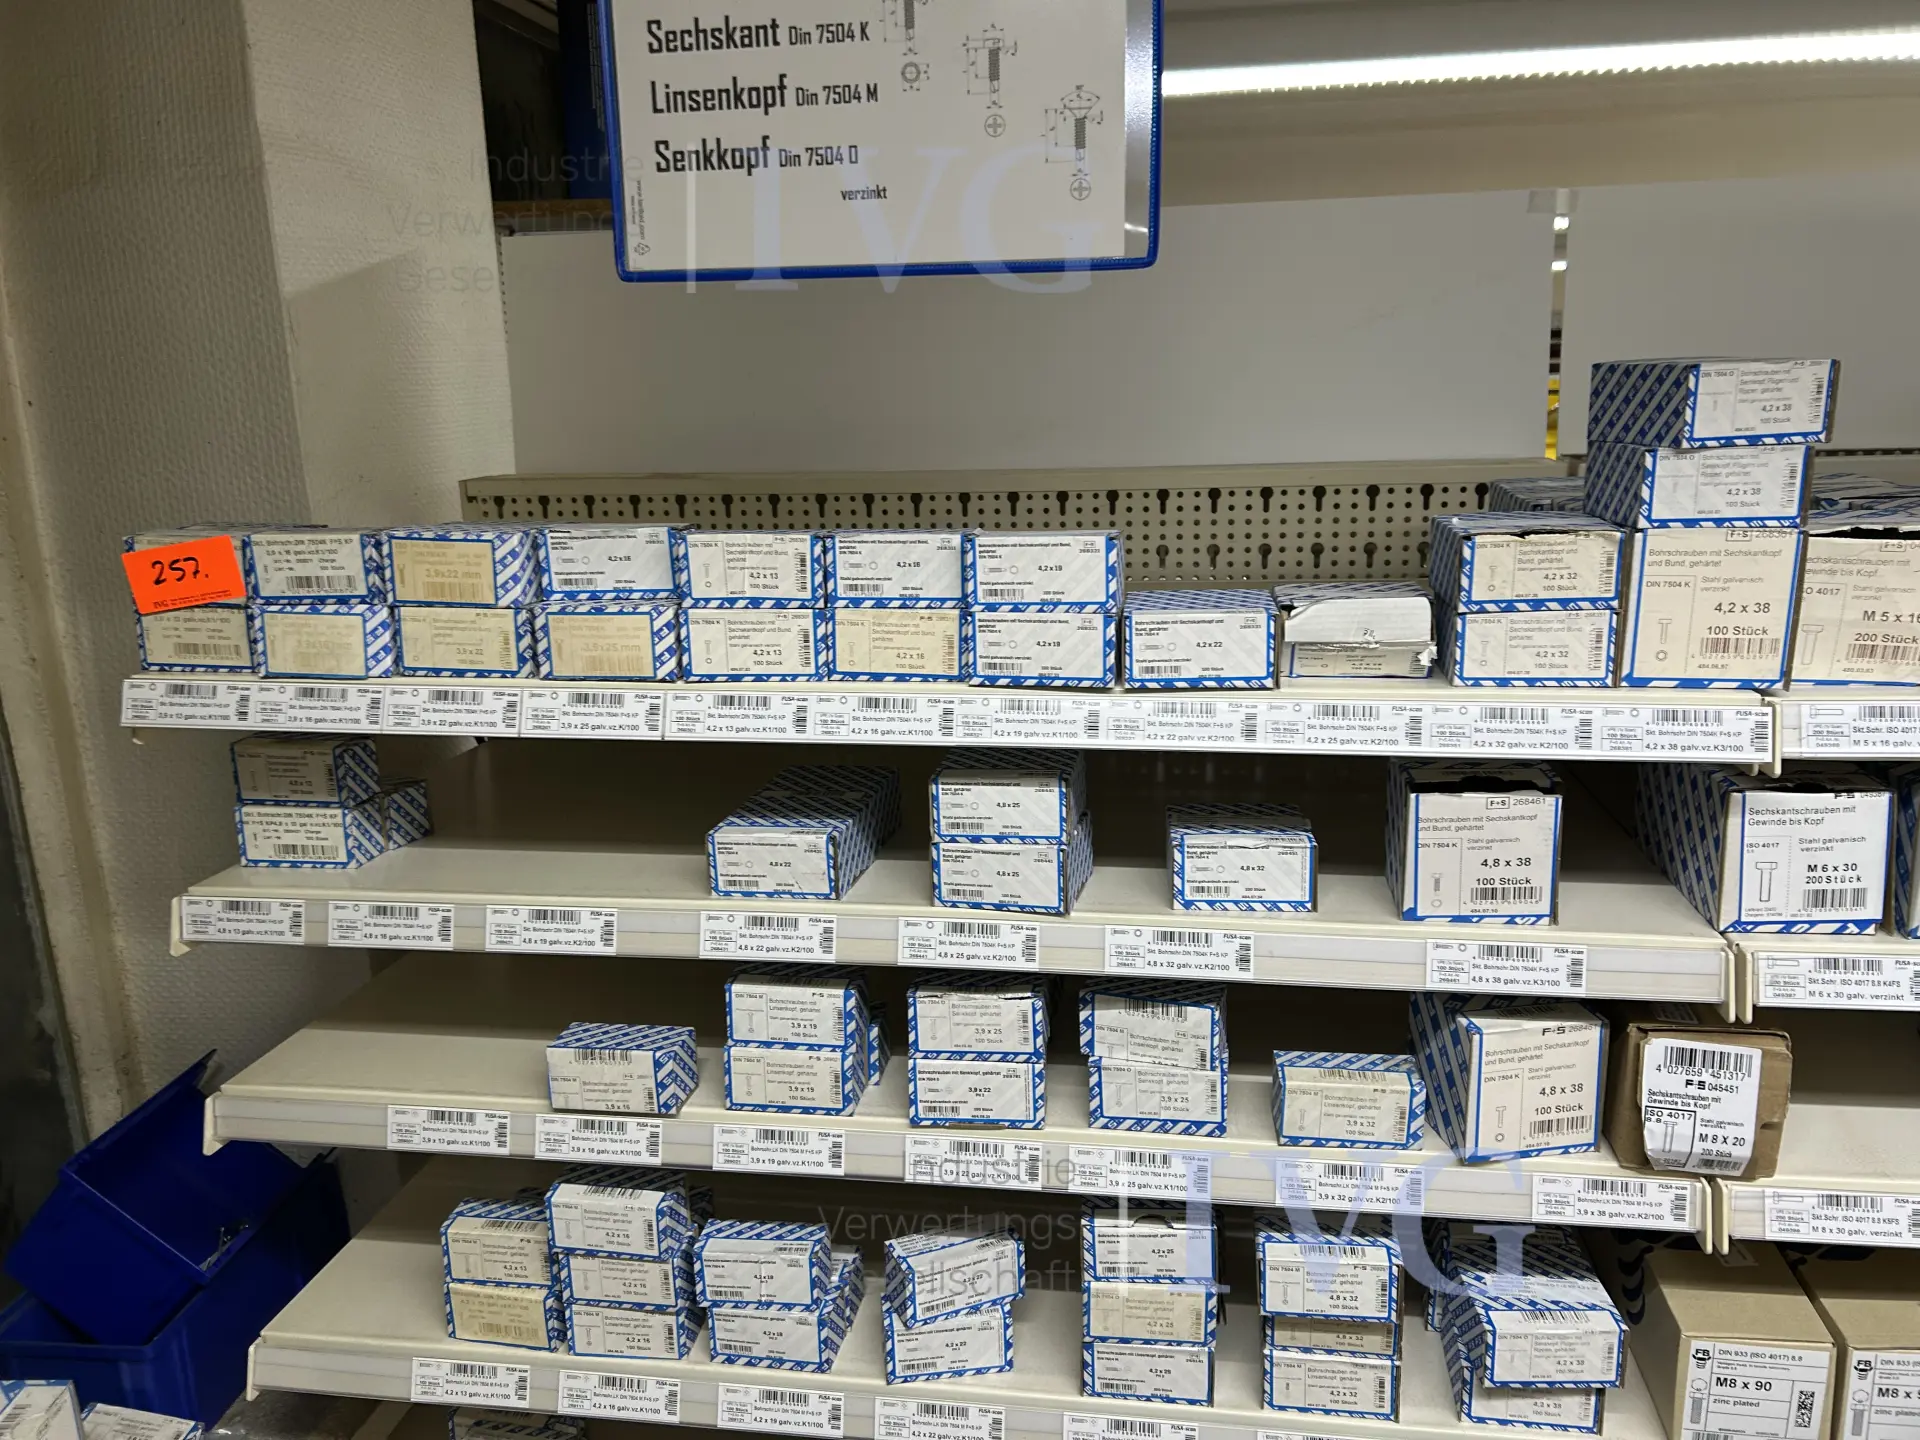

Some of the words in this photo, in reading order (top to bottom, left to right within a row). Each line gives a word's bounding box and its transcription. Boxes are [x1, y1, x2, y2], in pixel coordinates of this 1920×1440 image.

[647, 15, 780, 53] Sechskant
[789, 26, 811, 46] Din
[816, 23, 855, 44] 7504
[860, 21, 870, 41] K
[650, 74, 787, 115] Linsenkopf
[795, 87, 818, 107] Din
[823, 84, 861, 105] 7504
[867, 83, 878, 102] M
[655, 135, 770, 176] Senkkopf
[779, 149, 801, 168] Din
[806, 147, 843, 166] 7504
[840, 185, 887, 200] verzinkt
[1649, 549, 1708, 557] Bohrschrauben
[1724, 550, 1782, 558] Sechskantkopf
[1816, 587, 1840, 595] 4017
[1714, 602, 1736, 615] 4,2
[1740, 604, 1748, 613] x
[1753, 602, 1771, 613] 38
[1863, 611, 1875, 621] M
[1881, 612, 1890, 622] 5
[1895, 614, 1902, 622] x
[1707, 626, 1728, 635] 100
[1732, 626, 1768, 636] Stück
[1855, 633, 1877, 642] 200
[1881, 634, 1919, 644] Stück
[421, 719, 431, 727] 3,9
[1513, 798, 1545, 806] 268461
[1748, 806, 1840, 815] Sechskantschrauben
[1485, 814, 1537, 822] Sechskantkopf
[1748, 818, 1787, 826] Gewinde
[1804, 817, 1824, 826] Kopf
[1822, 836, 1866, 844] galvanisch
[1480, 858, 1500, 869] 4,8
[1516, 858, 1531, 867] 38
[1807, 864, 1818, 872] M
[1821, 864, 1828, 872] 6
[1843, 863, 1858, 872] 30
[1499, 877, 1532, 885] Stück
[1805, 876, 1823, 884] 200
[1542, 1026, 1565, 1036] F+S
[1486, 1047, 1531, 1057] Bohrschrauben
[1544, 1040, 1589, 1050] Sechskantkopf
[1656, 1064, 1661, 1072] 4
[1667, 1065, 1702, 1077] 027659
[1710, 1070, 1746, 1081] 451317
[1539, 1085, 1556, 1097] 4,8
[1570, 1083, 1584, 1093] 38
[1708, 1083, 1739, 1094] 045451
[1647, 1089, 1709, 1102] Sechskantschrauben
[1535, 1106, 1551, 1115] 100
[1554, 1103, 1583, 1114] Stück
[1647, 1097, 1678, 1106] Gewinde
[1694, 1101, 1711, 1110] Kopf
[1646, 1109, 1663, 1117] ISO
[1667, 1112, 1692, 1120] 4017
[1699, 1133, 1708, 1142] M
[1712, 1135, 1718, 1143] 8
[1721, 1135, 1729, 1145] X
[1732, 1137, 1745, 1146] 20
[1701, 1148, 1713, 1156] 200
[1715, 1149, 1732, 1158] Stück
[1716, 1377, 1737, 1388] M8
[1742, 1381, 1751, 1390] x
[1755, 1381, 1772, 1392] 90
[1878, 1387, 1899, 1398] M8
[1904, 1391, 1912, 1399] x
[1733, 1400, 1760, 1408] plated
